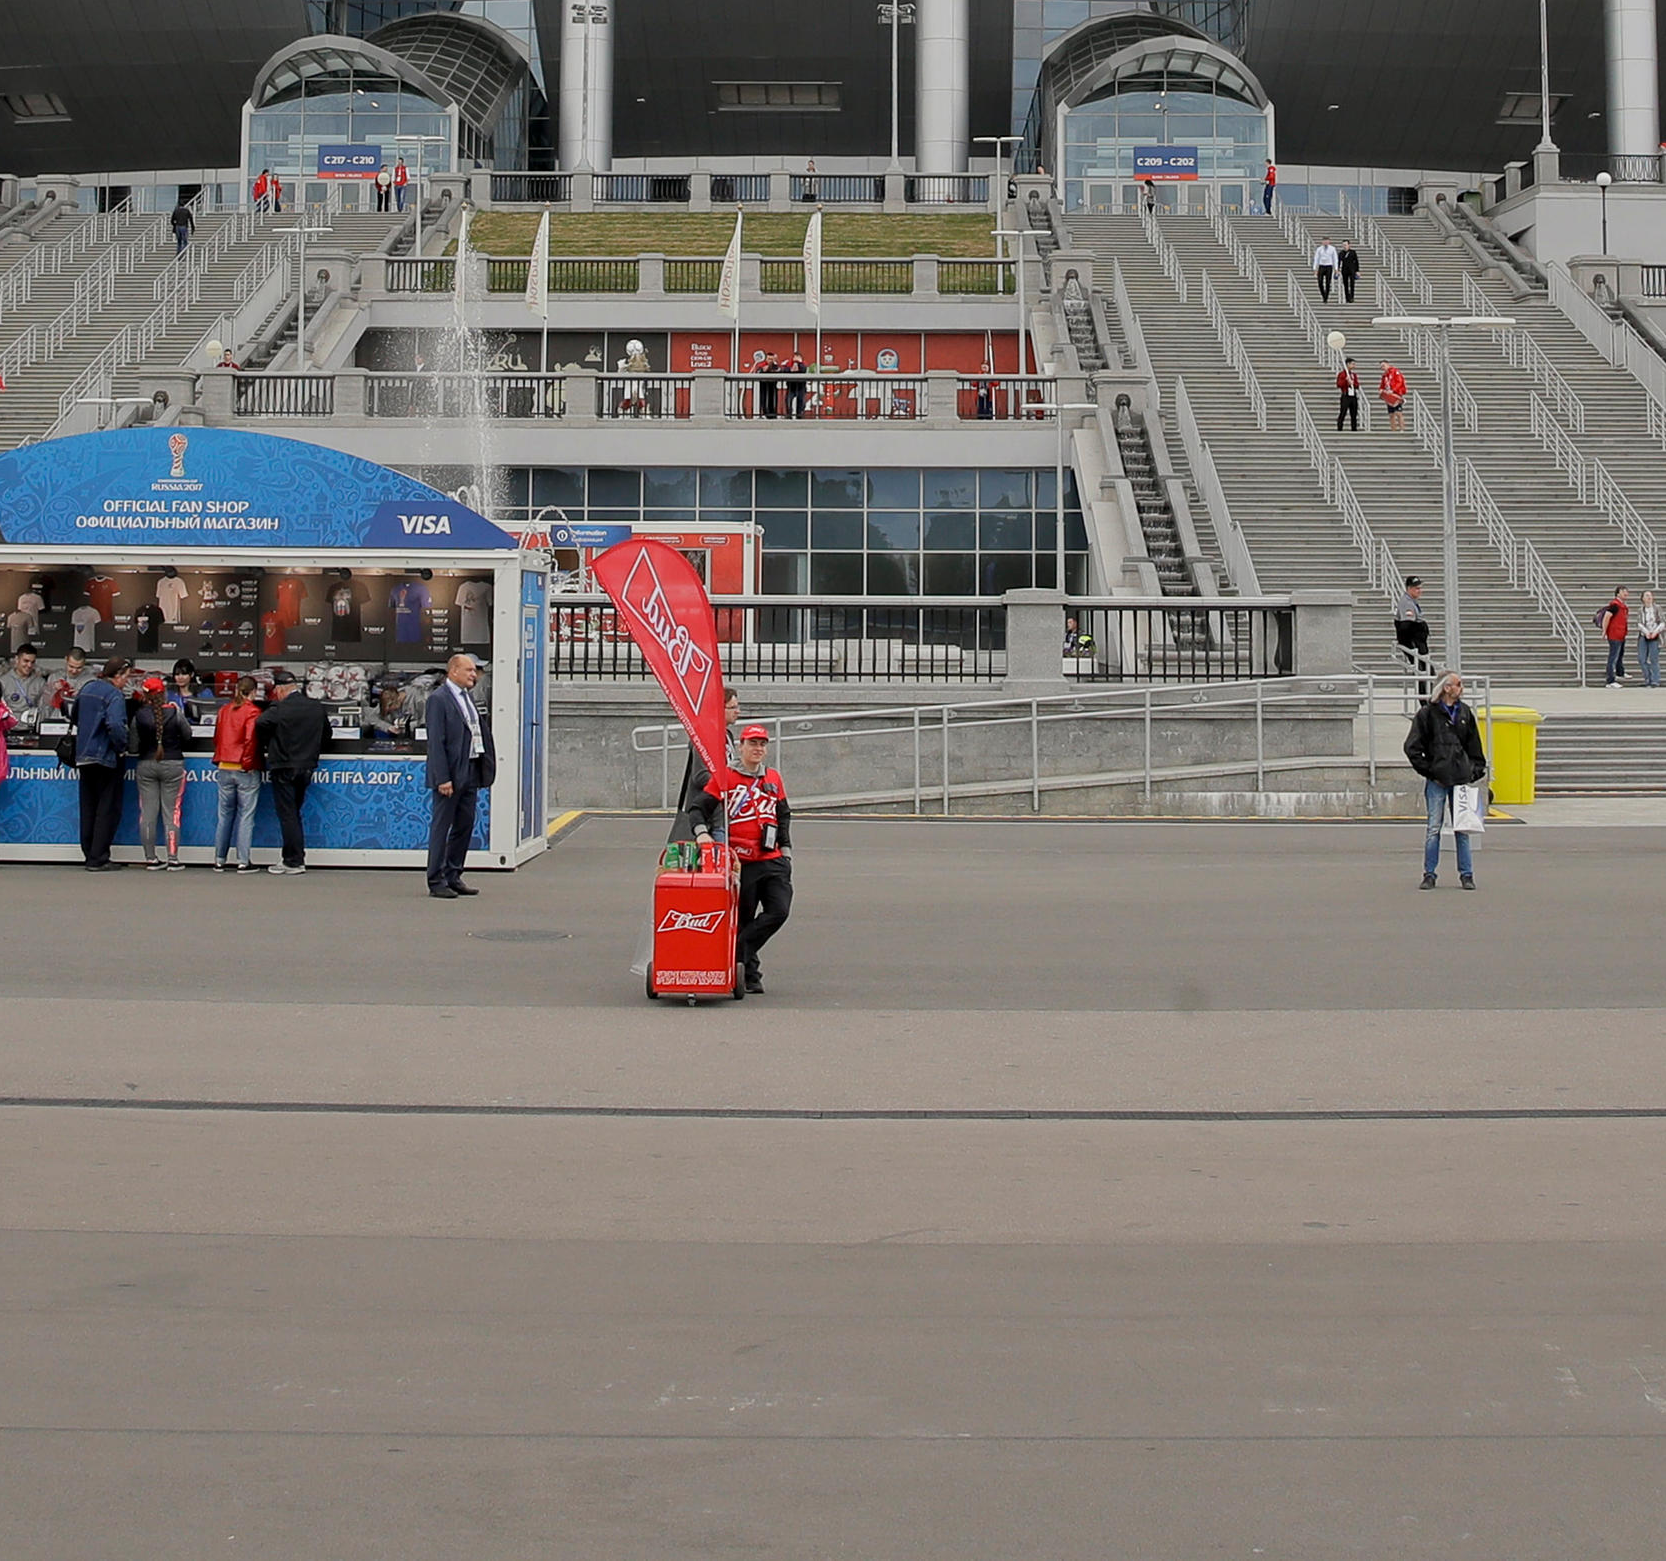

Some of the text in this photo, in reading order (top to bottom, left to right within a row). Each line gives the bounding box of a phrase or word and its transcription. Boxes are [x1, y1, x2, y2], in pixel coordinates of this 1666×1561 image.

[103, 499, 249, 513] OFFICIAL FAN SHOP
[75, 514, 279, 532] ОФИЦИАЛЬНЫЙ МАГАЗИН
[397, 515, 451, 535] VISA
[333, 771, 365, 784] FIFA
[367, 771, 402, 784] 2017
[1458, 785, 1469, 814] VISA
[671, 912, 710, 928] Bud
